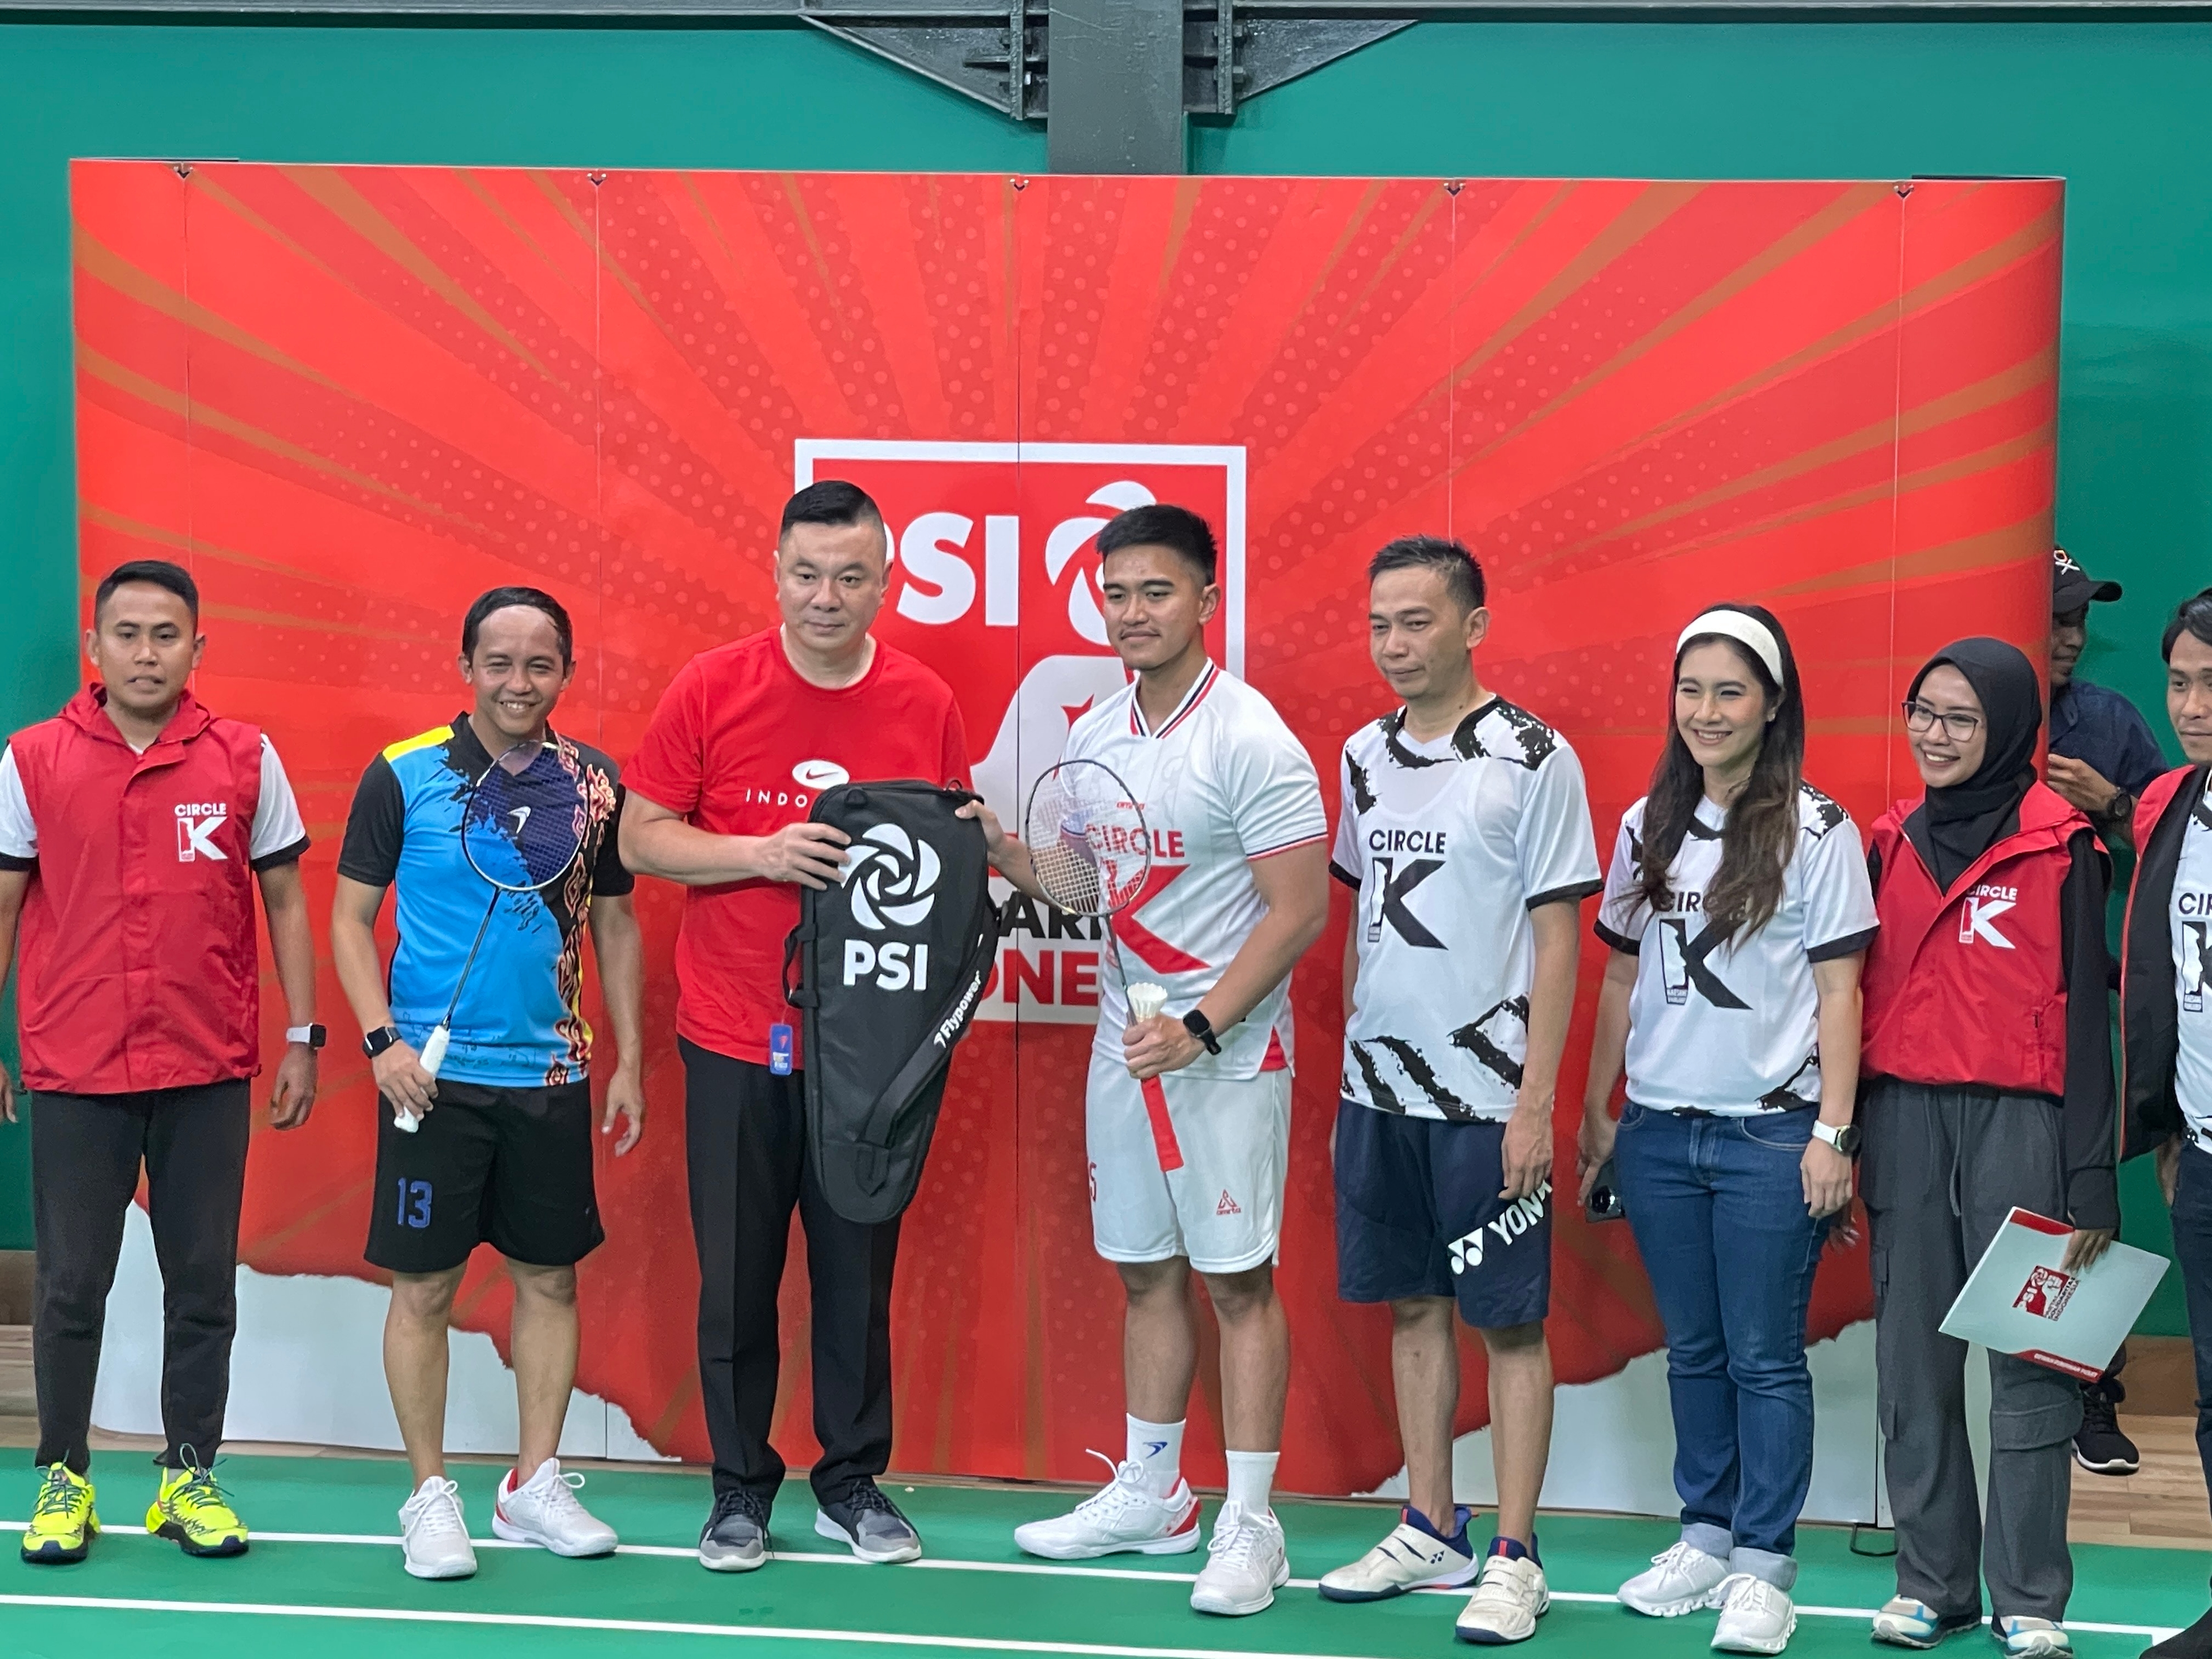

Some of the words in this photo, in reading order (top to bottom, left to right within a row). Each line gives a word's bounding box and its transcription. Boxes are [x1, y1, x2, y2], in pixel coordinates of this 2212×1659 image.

[887, 513, 1019, 626] SI
[175, 803, 226, 816] CIRCLE
[177, 816, 228, 862] K
[1086, 824, 1185, 858] CIRCLE
[1369, 830, 1446, 854] CIRCLE
[1368, 857, 1449, 950] K
[1959, 897, 2017, 949] K
[843, 939, 929, 991] PSI
[940, 970, 982, 1039] Flypower
[397, 1177, 433, 1228] 13
